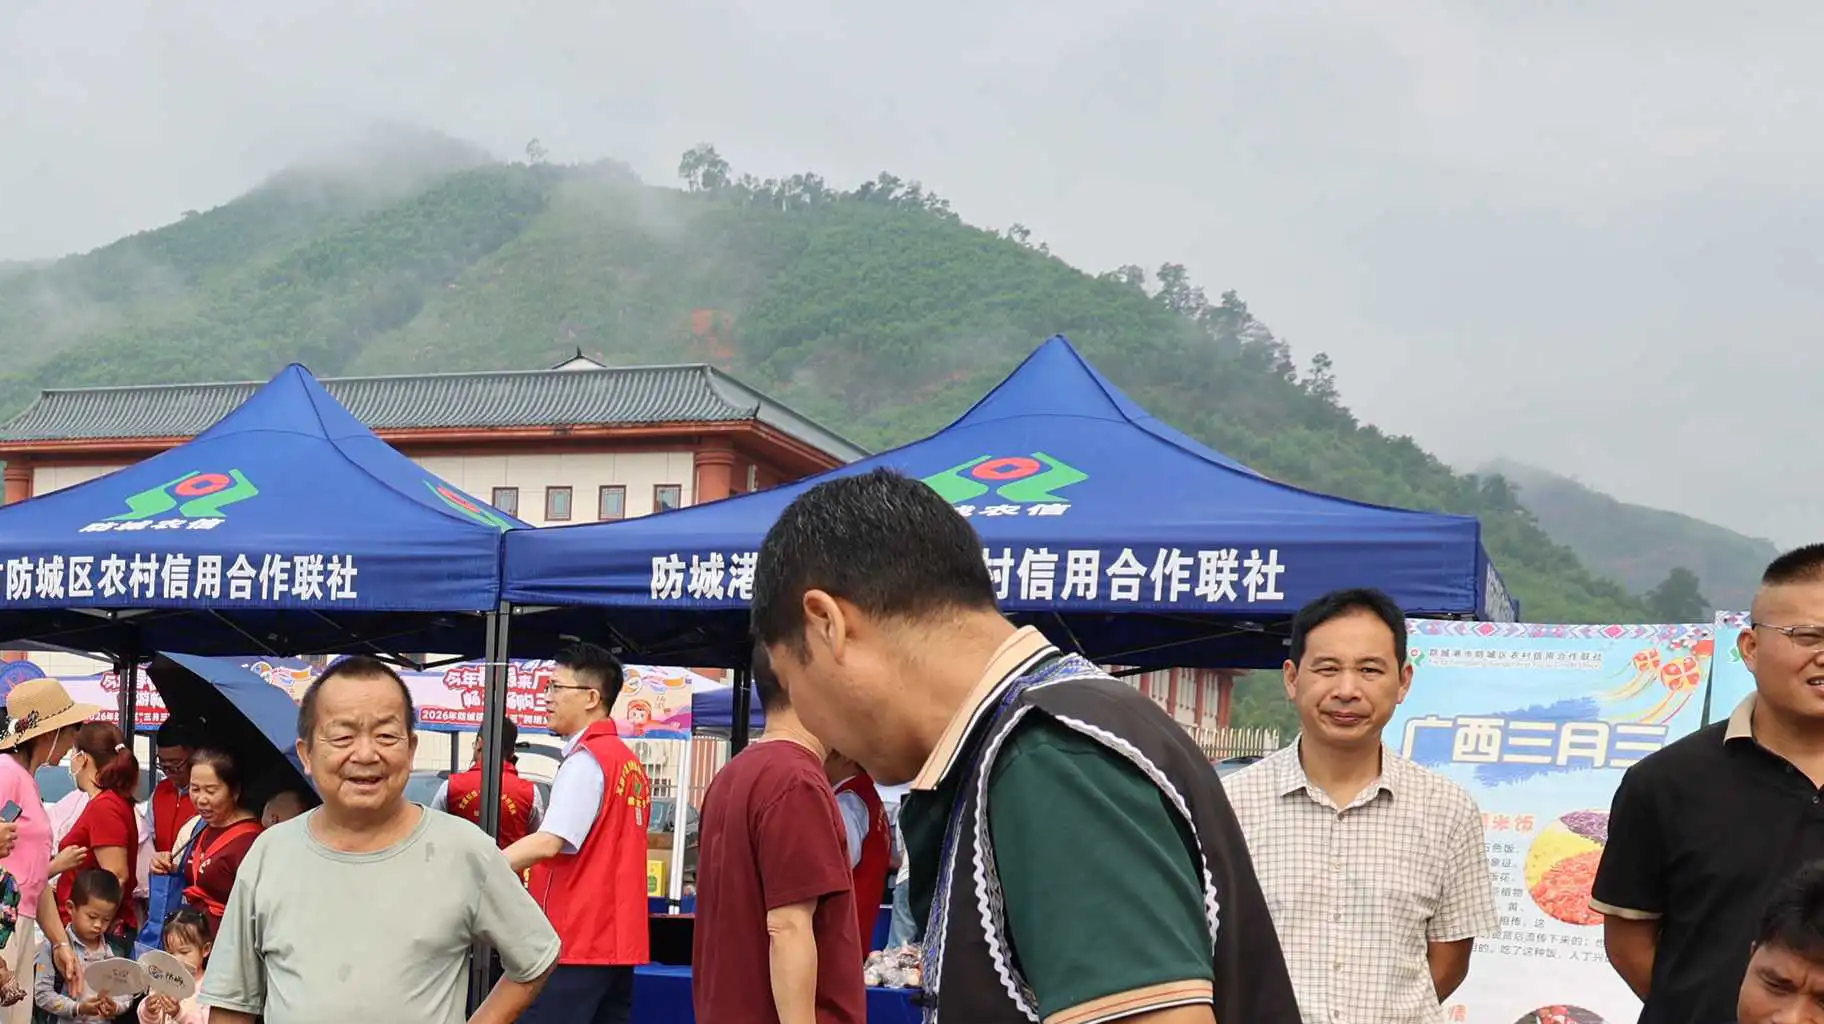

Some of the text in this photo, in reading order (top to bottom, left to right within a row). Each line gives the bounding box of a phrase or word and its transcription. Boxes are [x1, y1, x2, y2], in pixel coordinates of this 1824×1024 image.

[1402, 714, 1669, 769] 广西三月三
